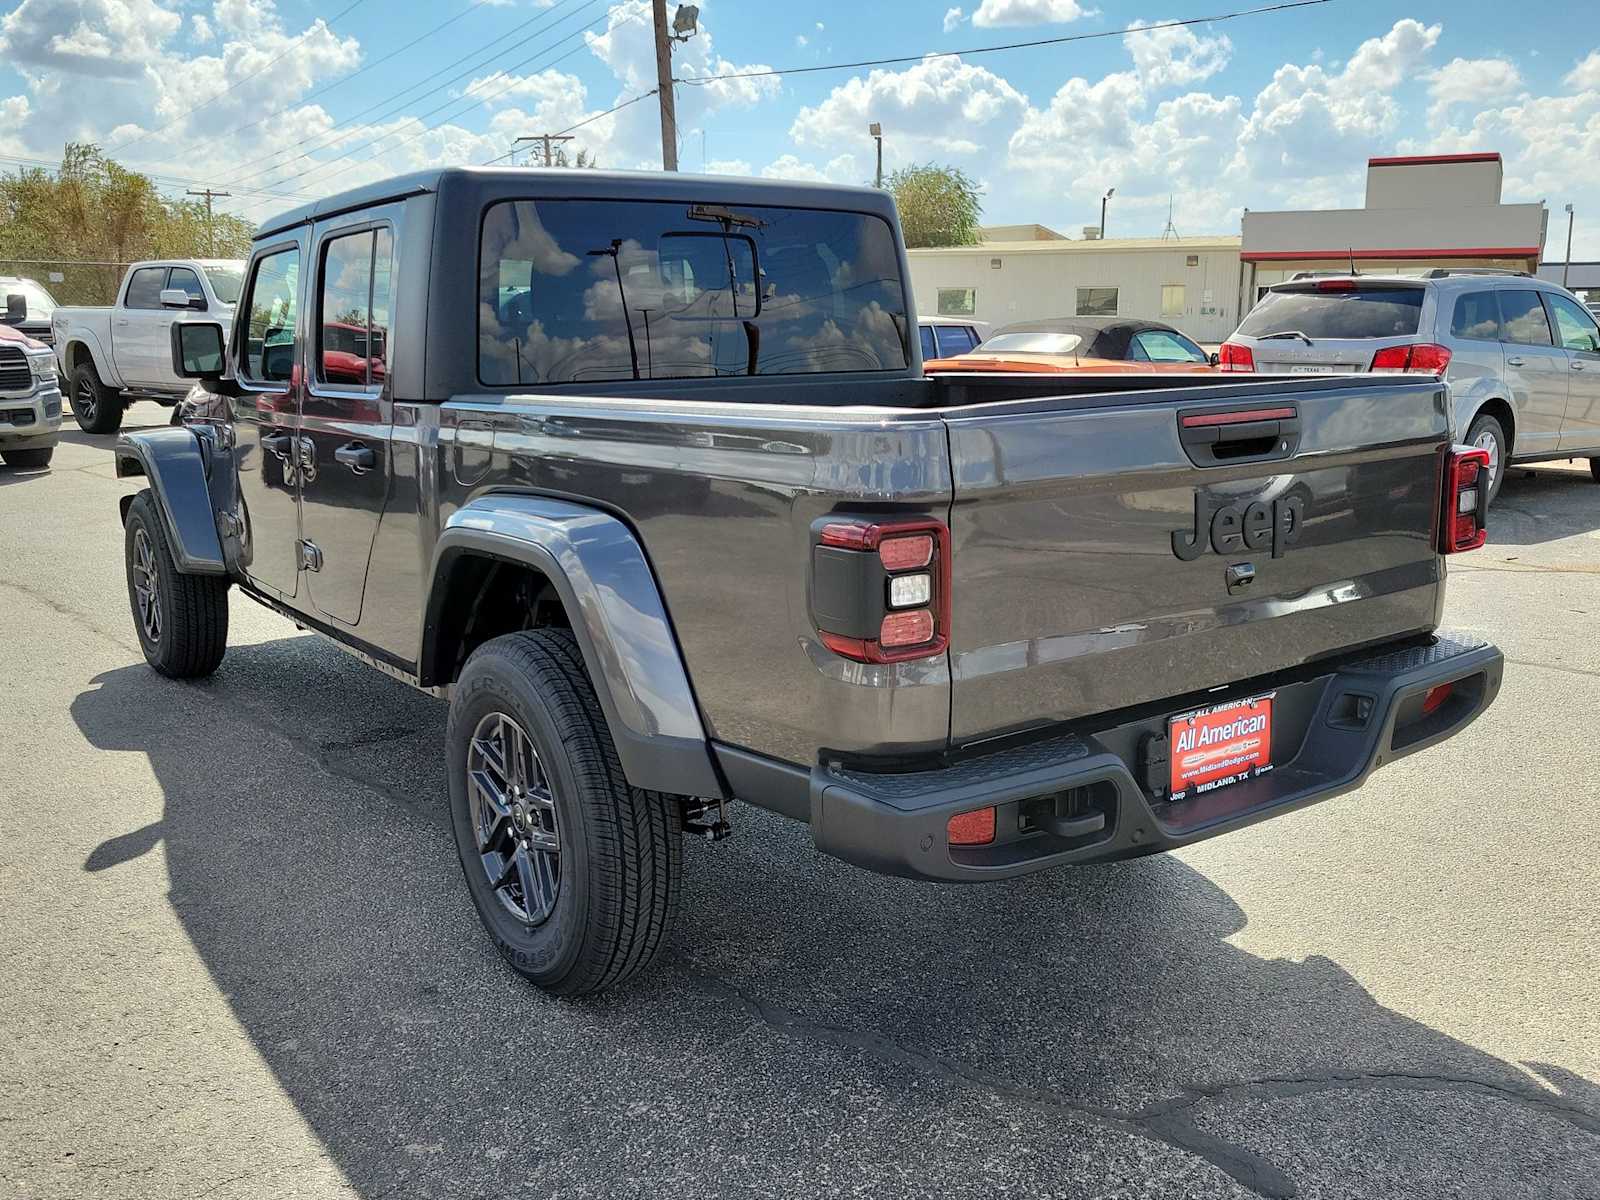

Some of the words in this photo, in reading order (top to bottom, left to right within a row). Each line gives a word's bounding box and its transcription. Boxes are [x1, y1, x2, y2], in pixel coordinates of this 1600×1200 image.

[1171, 487, 1303, 561] Jeep
[1195, 708, 1210, 718] ALL
[1212, 697, 1253, 713] AMERICAN
[1176, 729, 1196, 753] All
[1198, 714, 1266, 747] American
[1181, 753, 1259, 779] www.MidlandDodge.com
[1197, 777, 1237, 793] MIDLAND,
[1238, 771, 1249, 781] TX
[1170, 791, 1186, 801] Jeep
